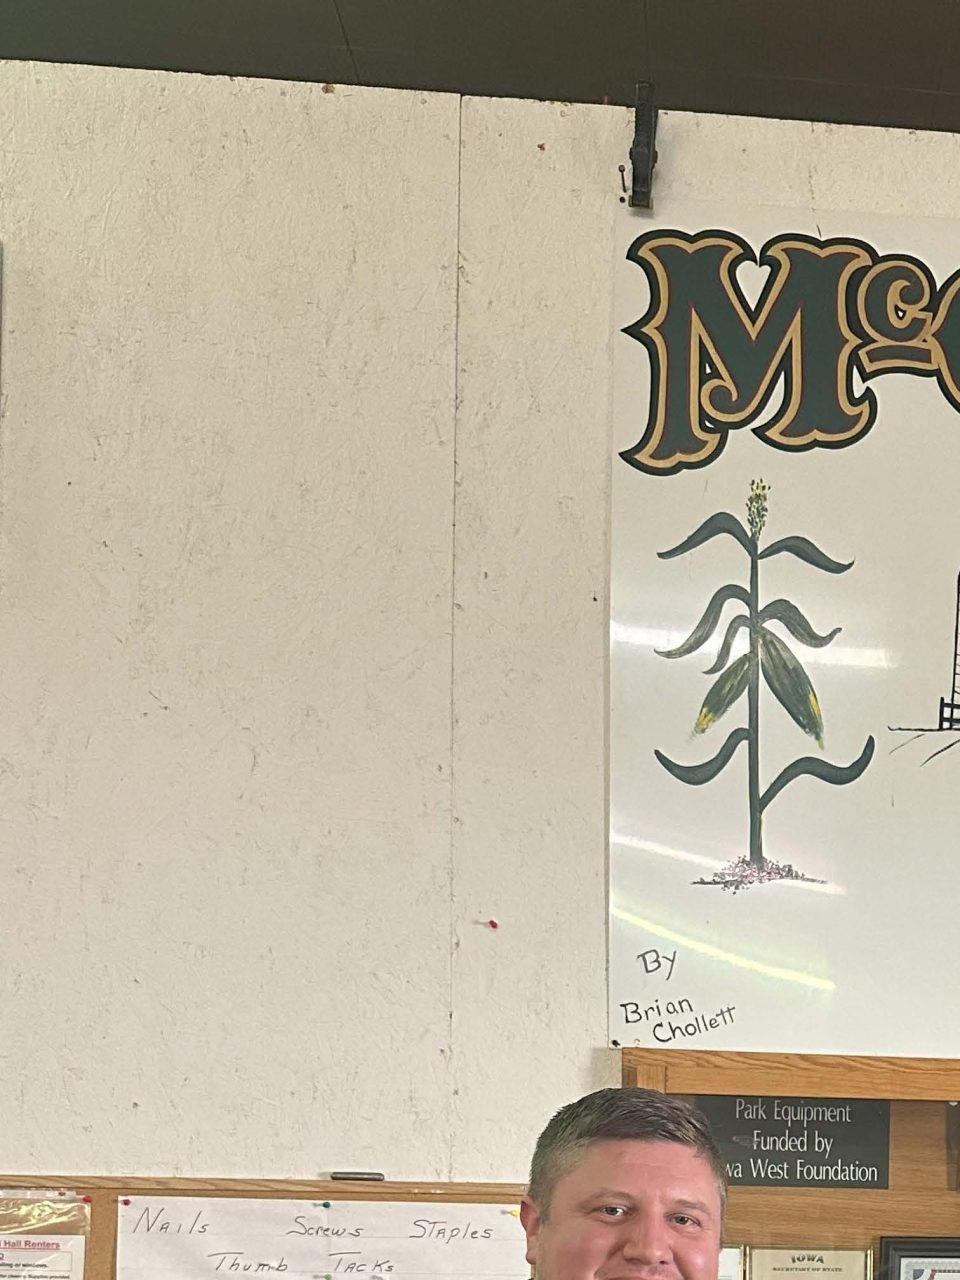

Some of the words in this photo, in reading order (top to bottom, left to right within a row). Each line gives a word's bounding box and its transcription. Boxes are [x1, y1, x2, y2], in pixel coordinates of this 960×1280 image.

[636, 949, 677, 981] By
[619, 998, 693, 1024] Brian
[652, 1005, 736, 1042] Chollett
[736, 1098, 766, 1120] Park
[774, 1099, 852, 1127] Equipment
[753, 1130, 808, 1152] Funded
[814, 1130, 834, 1159] by
[725, 1163, 743, 1178] wa
[750, 1158, 790, 1180] West
[796, 1158, 878, 1182] Foundation
[208, 1251, 288, 1272] Thumb
[791, 1253, 825, 1264] IOWA
